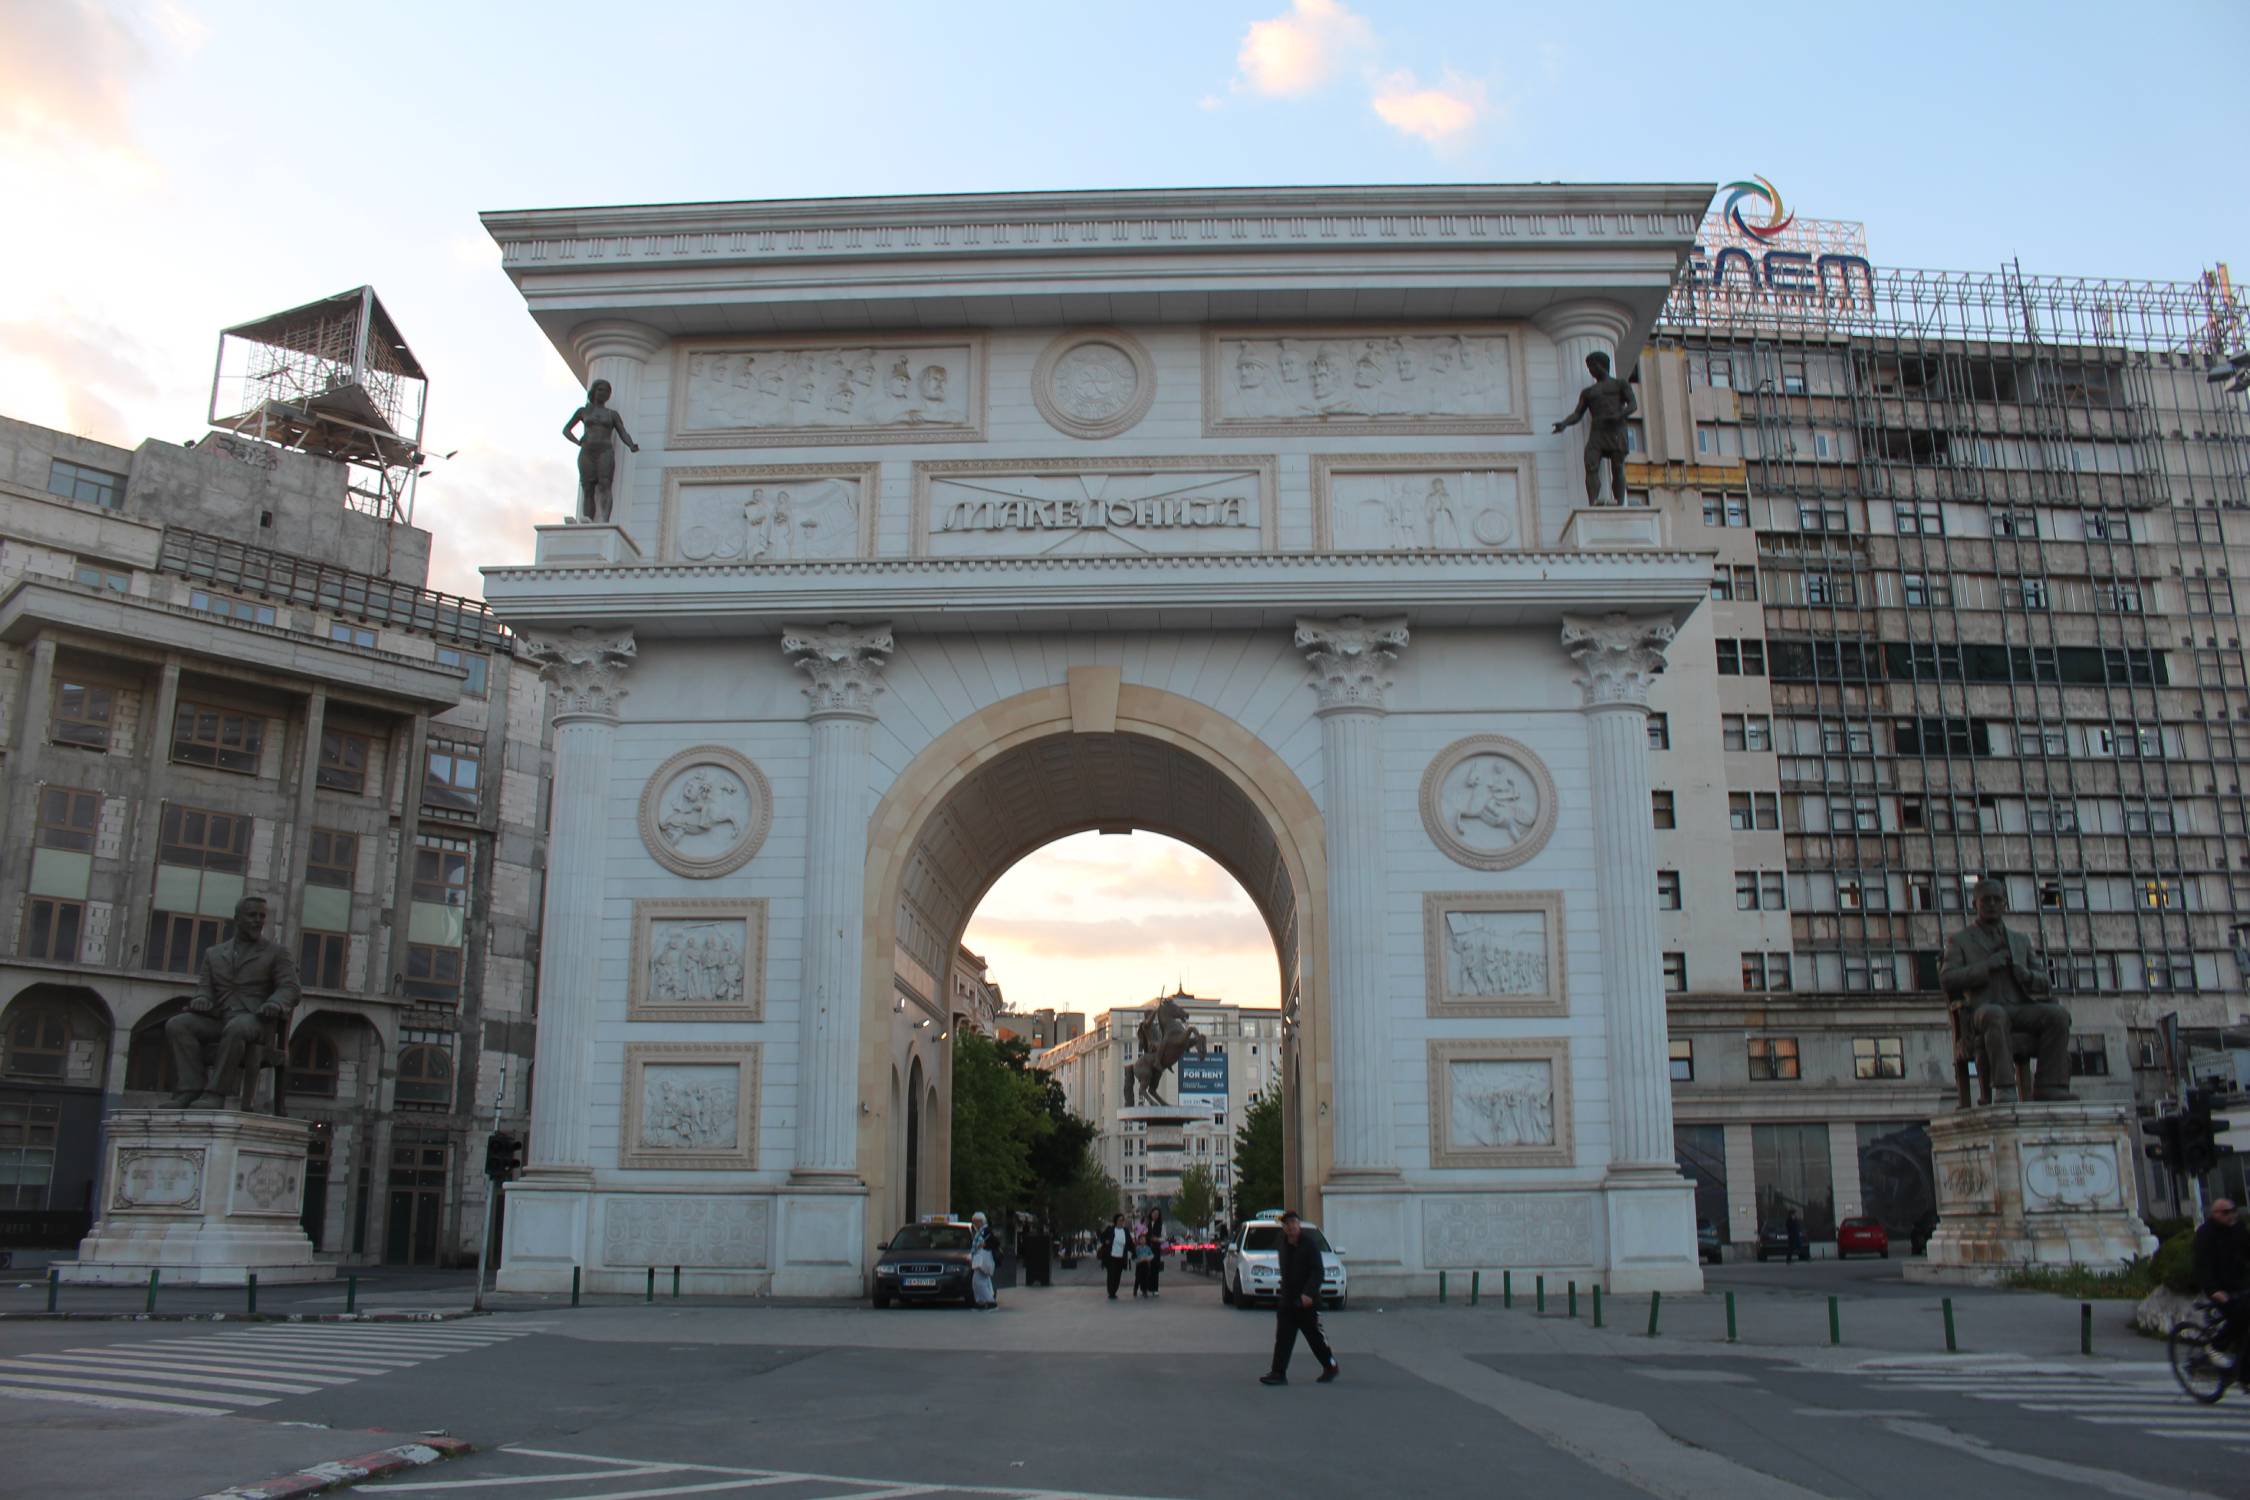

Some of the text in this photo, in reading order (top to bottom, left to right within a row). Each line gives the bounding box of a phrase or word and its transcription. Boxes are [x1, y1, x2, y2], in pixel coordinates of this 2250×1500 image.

[943, 497, 1248, 531] МАКЕДОНИЈА
[1183, 1071, 1223, 1079] FOR RENT
